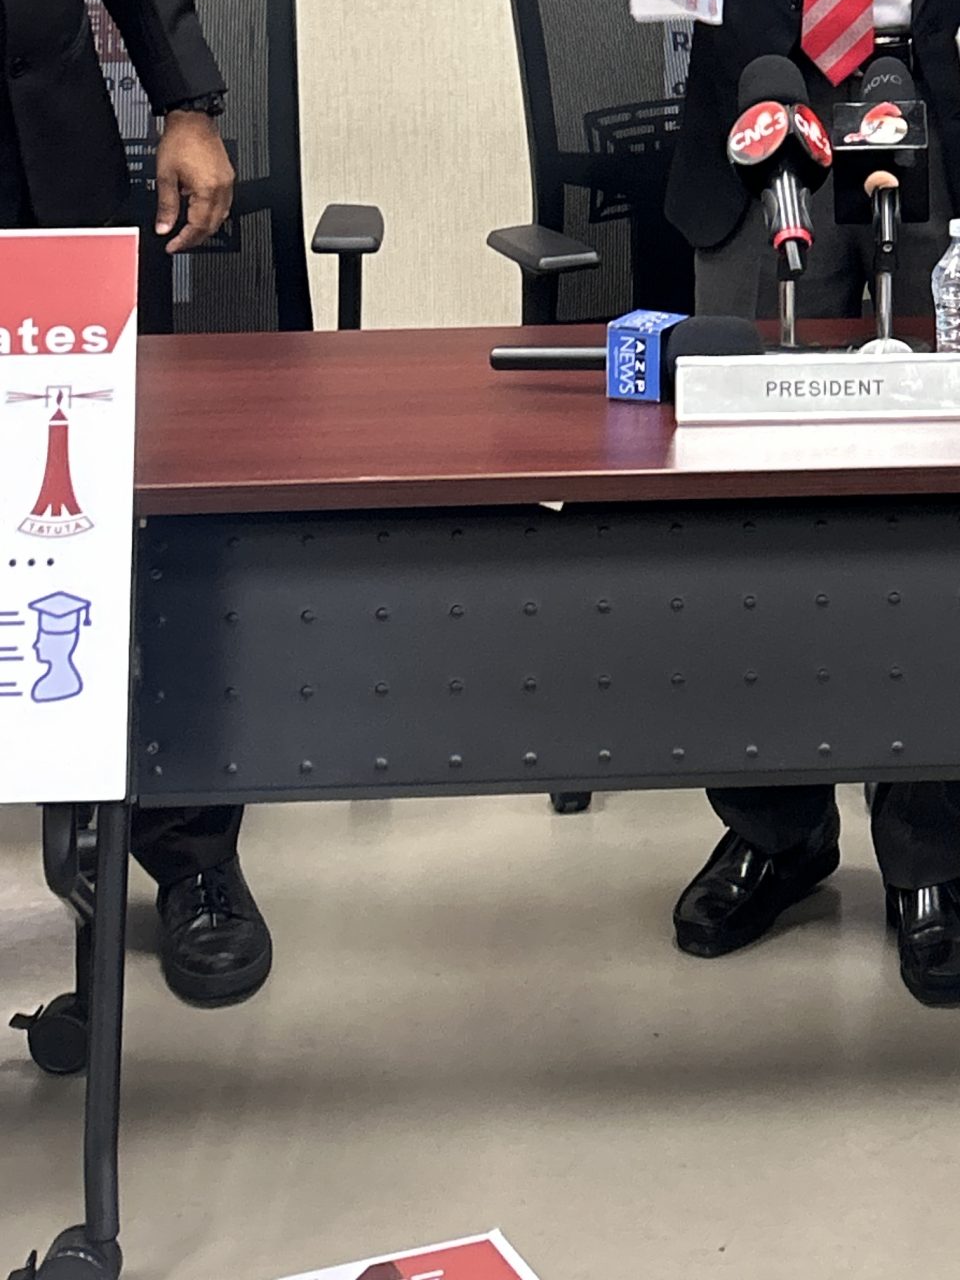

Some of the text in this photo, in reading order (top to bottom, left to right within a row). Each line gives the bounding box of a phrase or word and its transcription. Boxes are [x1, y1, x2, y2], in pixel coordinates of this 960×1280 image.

[730, 111, 786, 152] CNC3
[619, 336, 635, 395] NEWS
[766, 379, 884, 397] PRESIDENT
